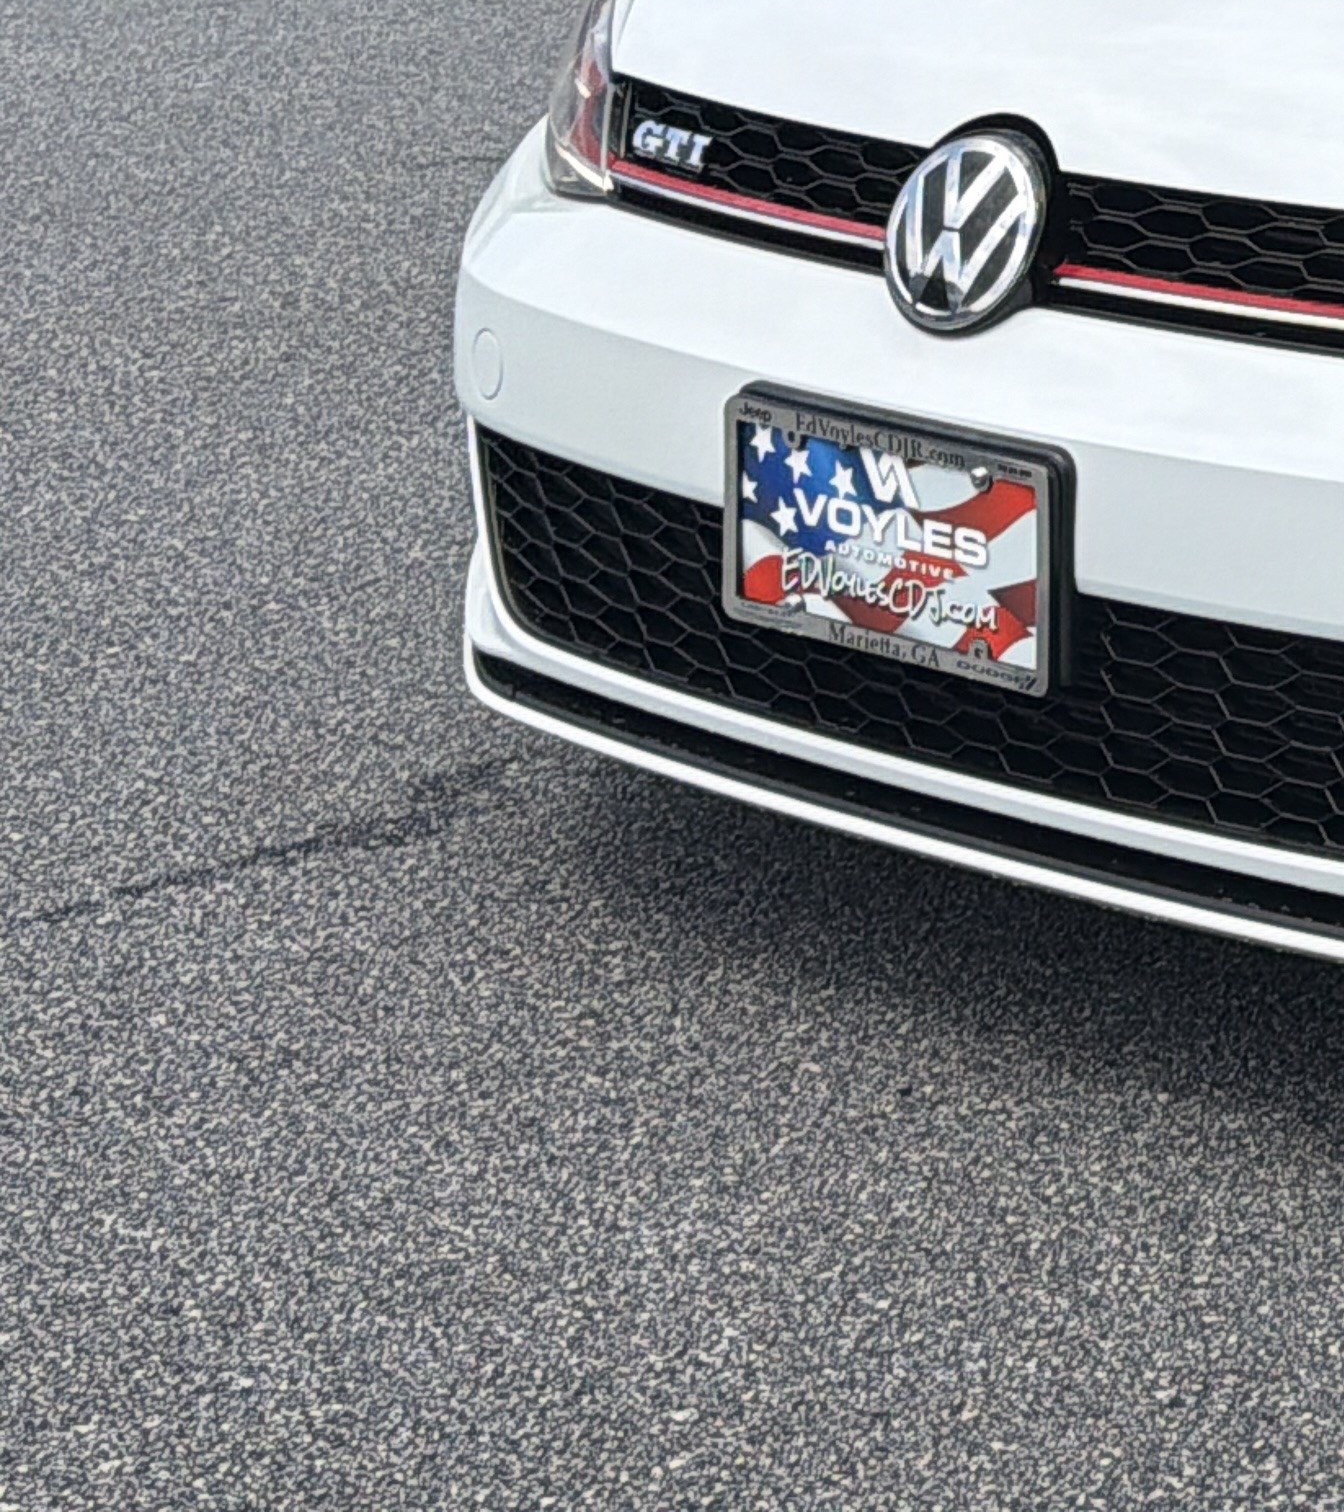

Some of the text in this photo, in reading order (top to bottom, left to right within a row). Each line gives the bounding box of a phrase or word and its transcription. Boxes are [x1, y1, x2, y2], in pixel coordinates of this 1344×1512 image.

[632, 120, 714, 168] GTI
[793, 488, 987, 566] VOYLES
[825, 539, 954, 579] AUTOMOTIVE
[911, 644, 940, 668] GA
